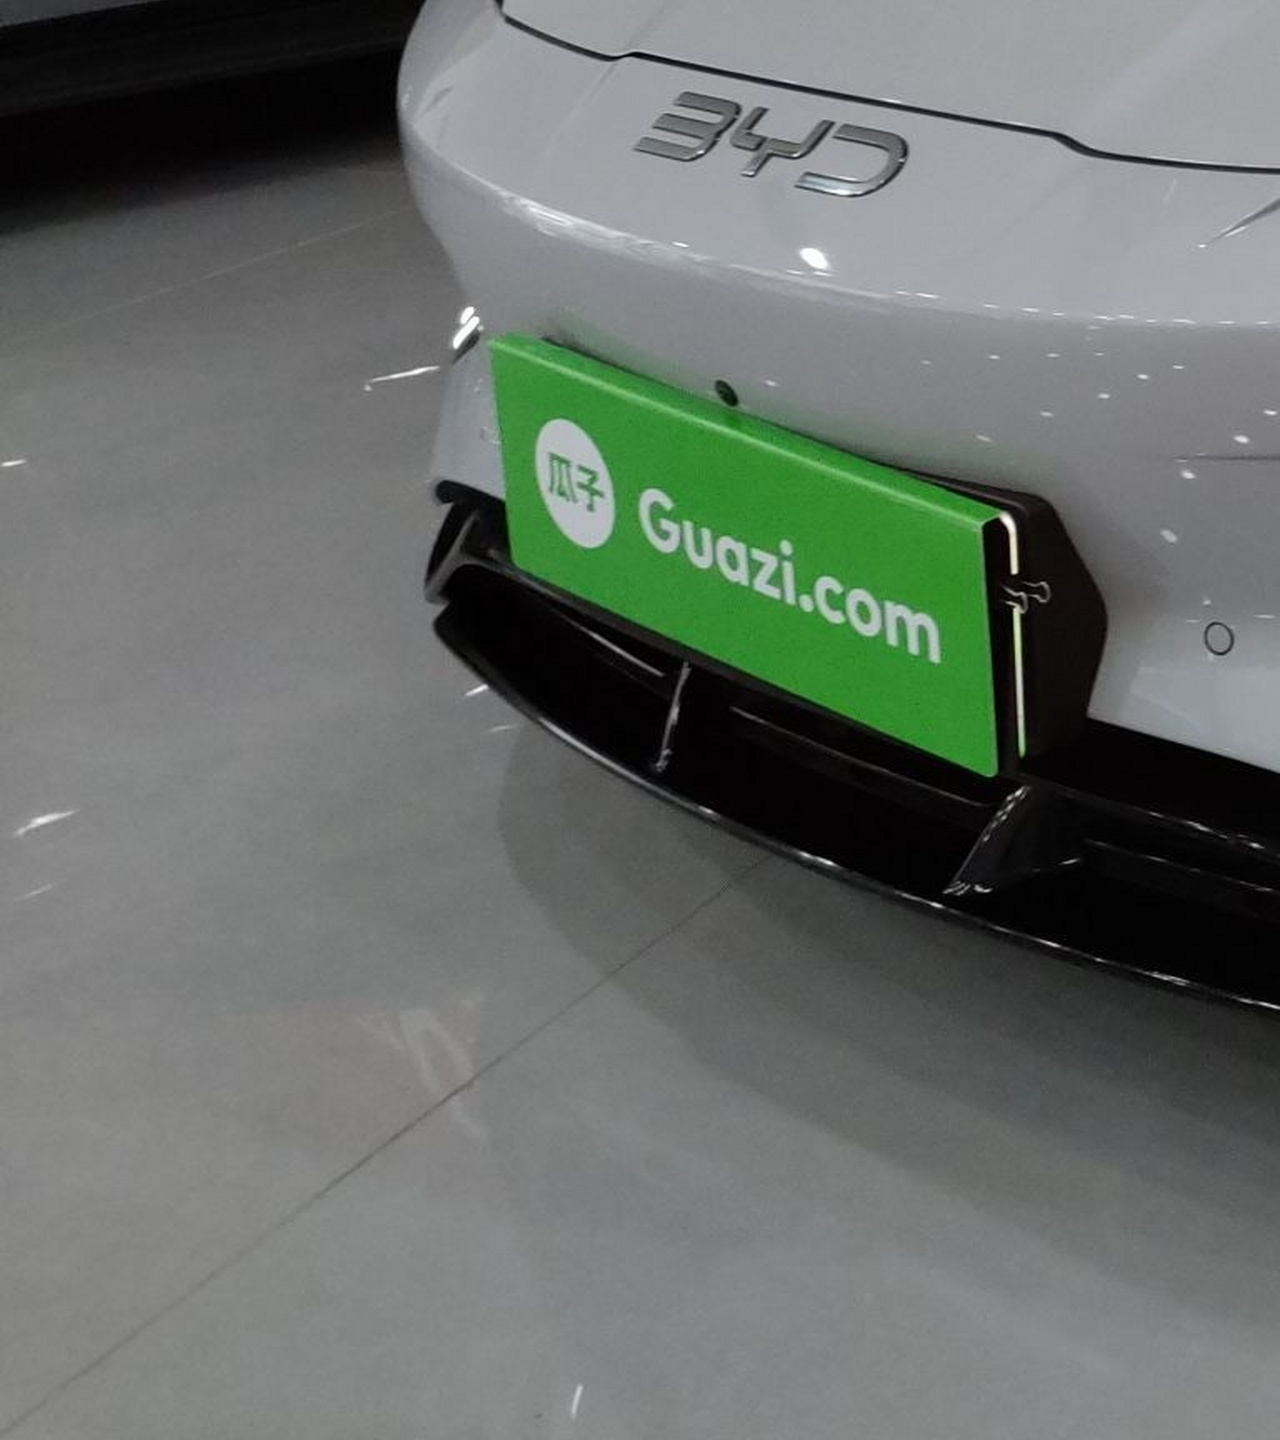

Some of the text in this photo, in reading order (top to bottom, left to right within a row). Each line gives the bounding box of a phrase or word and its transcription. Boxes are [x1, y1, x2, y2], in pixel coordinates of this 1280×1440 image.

[633, 91, 909, 197] BYD
[547, 452, 605, 513] 瓜子
[638, 487, 941, 664] Guazi.com
